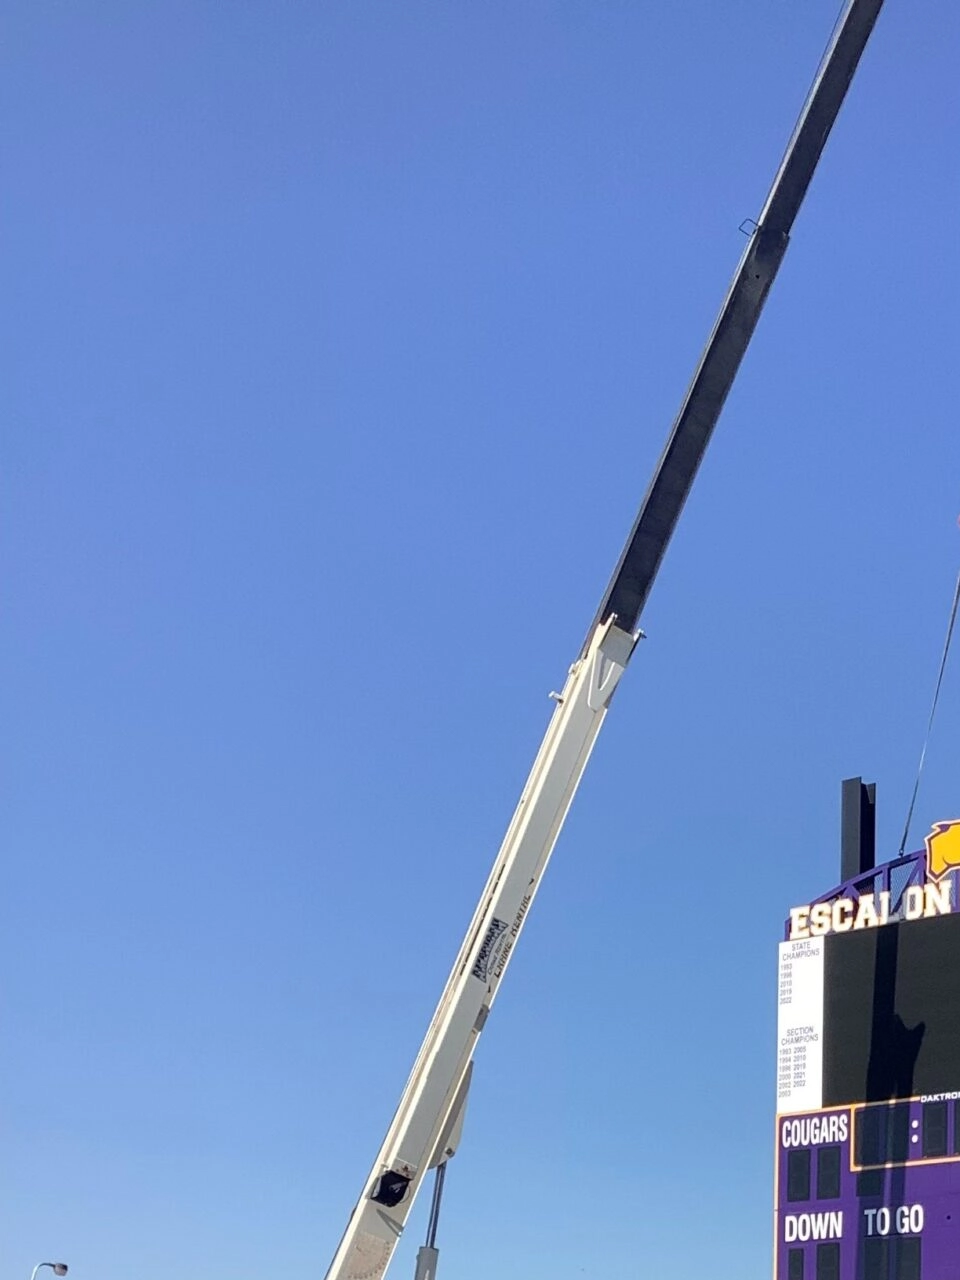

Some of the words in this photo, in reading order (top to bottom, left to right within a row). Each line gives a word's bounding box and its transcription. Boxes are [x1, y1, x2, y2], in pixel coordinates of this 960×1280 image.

[789, 879, 952, 941] ESCALON
[782, 948, 820, 961] CHAMPIONS
[792, 941, 811, 951] STATE
[781, 1033, 819, 1046] CHAMPIONS
[787, 1026, 814, 1037] SECTION
[782, 1114, 848, 1148] COUGARS
[784, 1211, 843, 1242] DOWN
[864, 1207, 890, 1236] TO
[896, 1204, 924, 1233] GO
